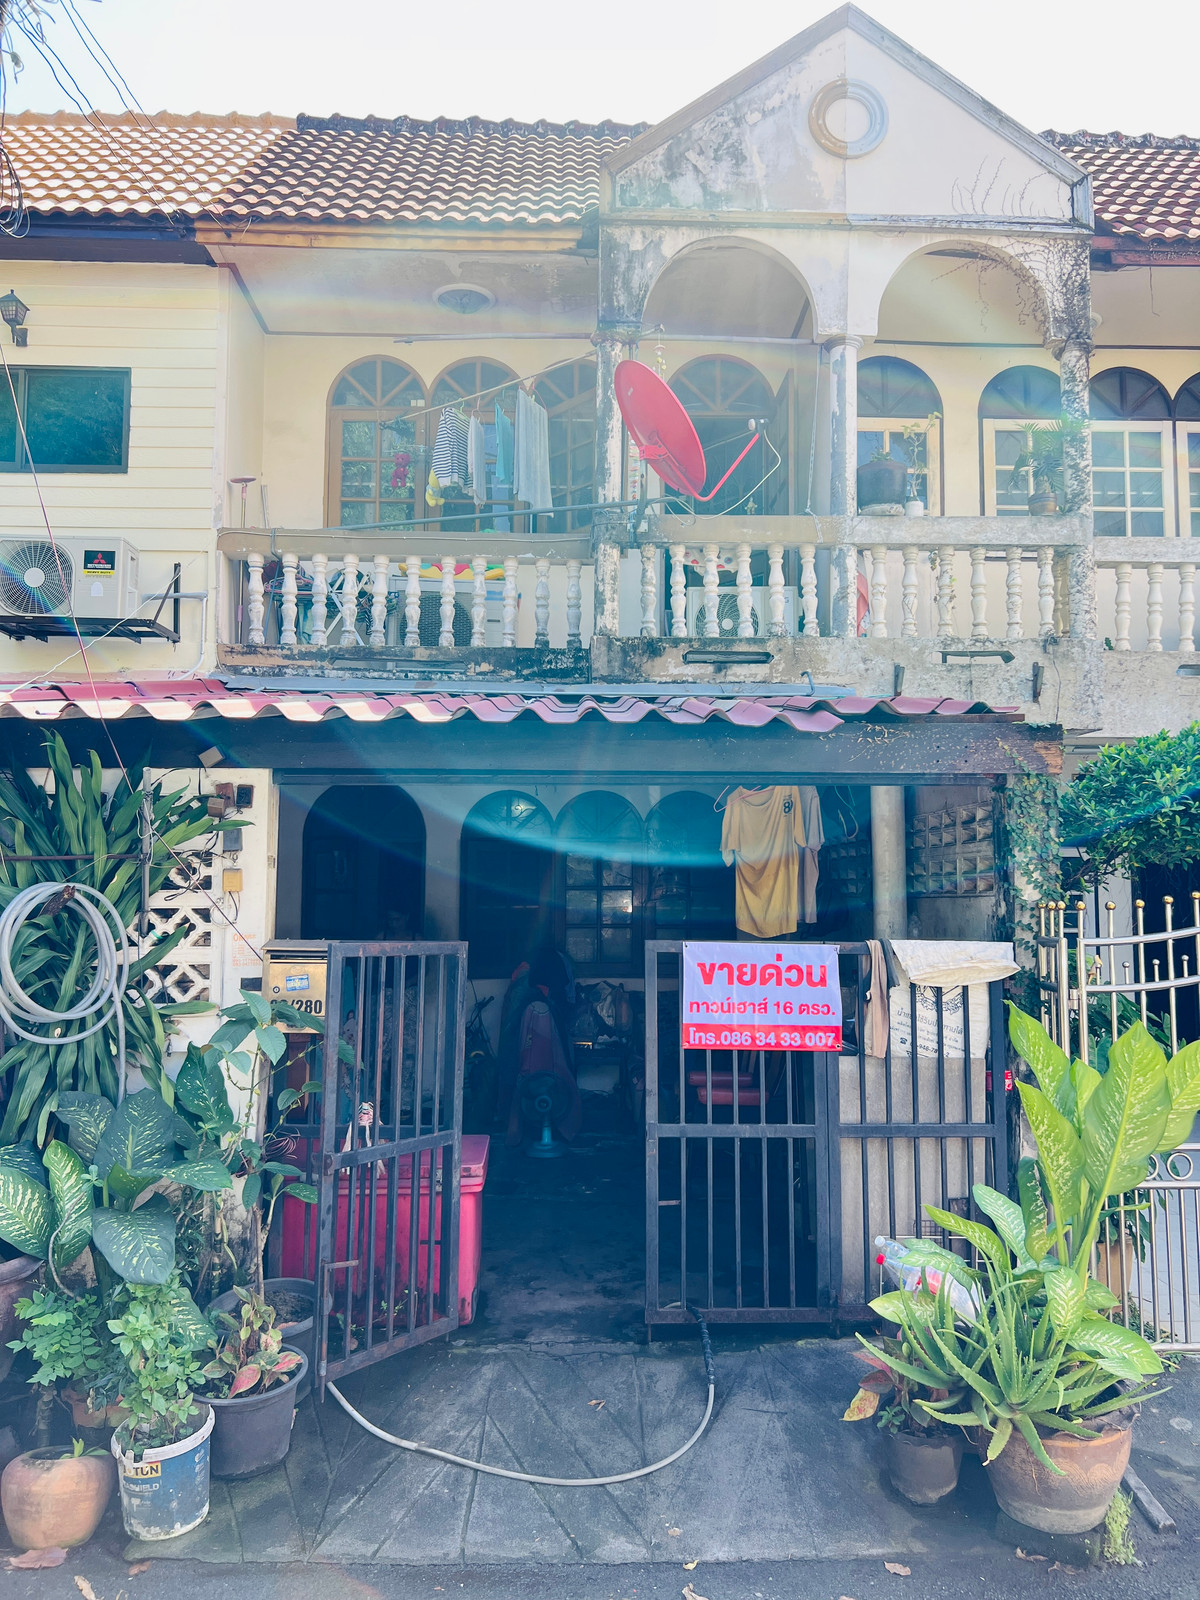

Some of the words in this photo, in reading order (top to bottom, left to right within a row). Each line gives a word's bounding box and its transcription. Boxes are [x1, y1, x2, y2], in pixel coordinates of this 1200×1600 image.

[697, 953, 827, 987] ขายด่วน
[270, 999, 323, 1014] /280
[689, 996, 768, 1015] ทาวน์เฮาส์
[773, 1001, 794, 1015] 16
[798, 1002, 836, 1016] ตรว.
[755, 1032, 776, 1046] 34
[780, 1032, 801, 1046] 33
[805, 1032, 836, 1047] 007
[123, 1464, 159, 1476] TUN
